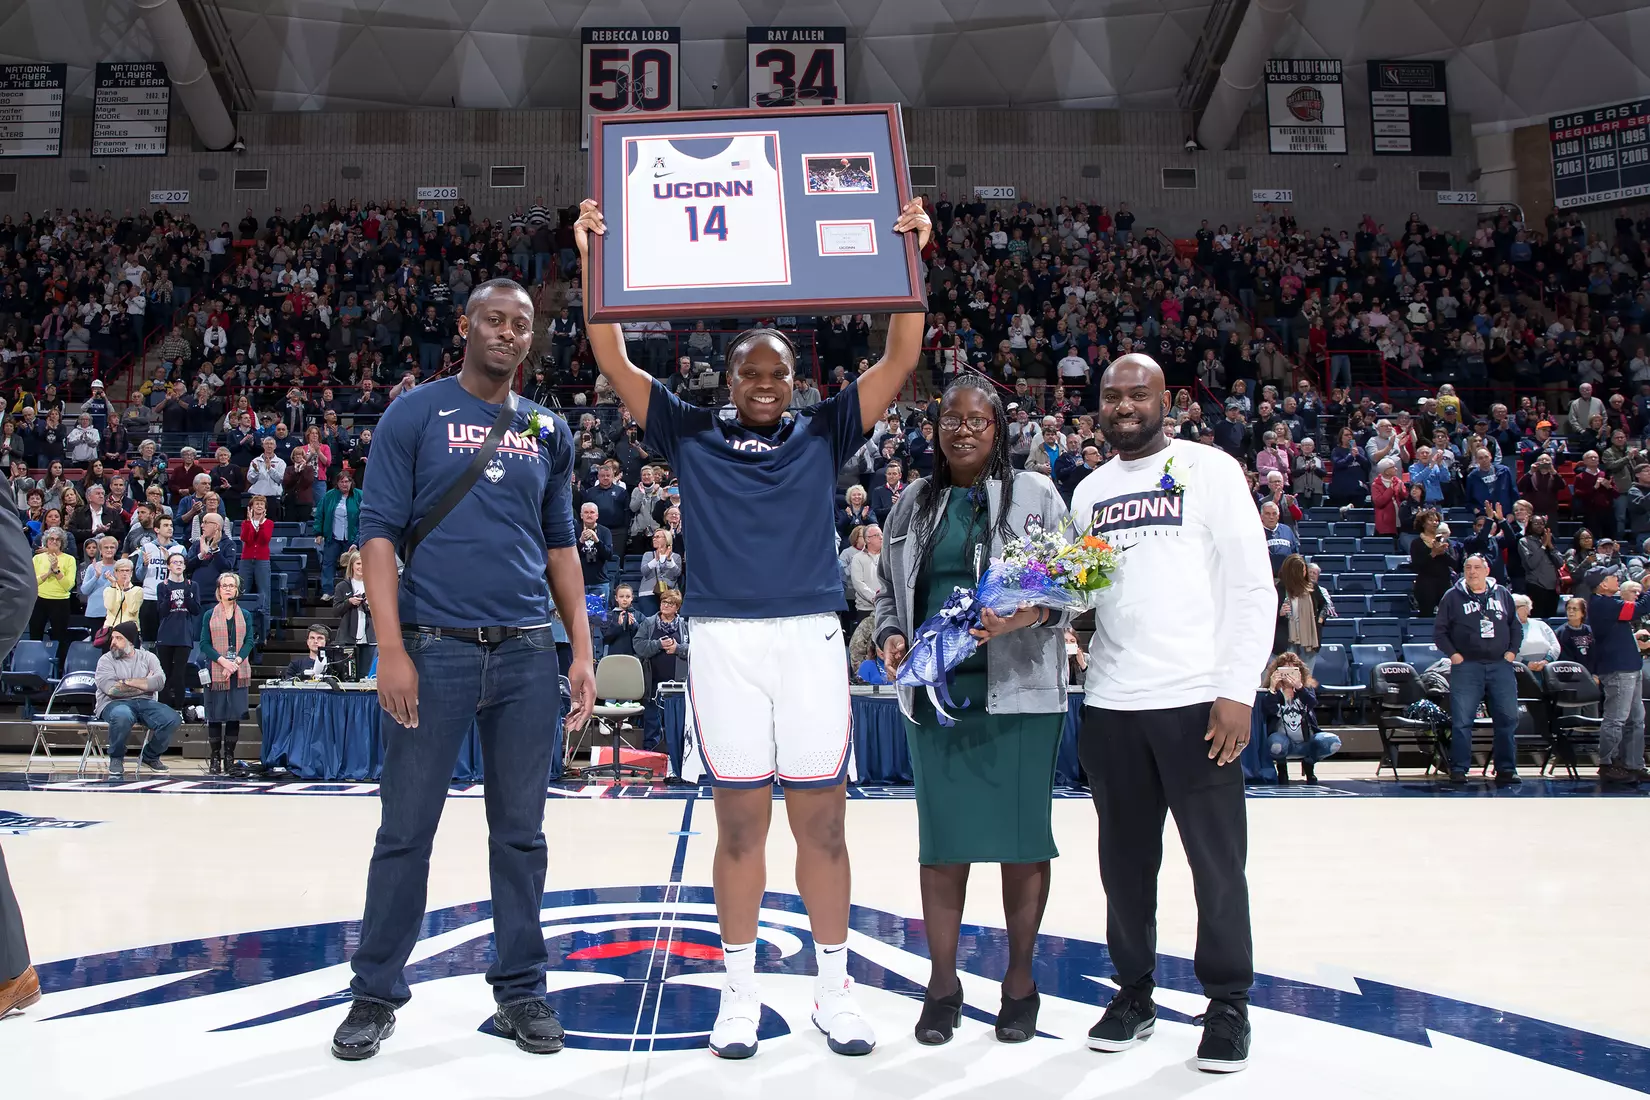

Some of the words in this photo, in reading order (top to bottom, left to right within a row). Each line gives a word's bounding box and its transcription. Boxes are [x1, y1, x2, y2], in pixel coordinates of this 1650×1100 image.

[592, 30, 639, 42] REBECCA
[642, 30, 670, 41] LOBO
[768, 30, 788, 41] RAY
[792, 30, 825, 41] ALLEN
[5, 65, 51, 73] NATIONAL
[110, 64, 157, 72] NATIONAL
[1265, 60, 1289, 74] GENO
[1293, 60, 1341, 74] AURIEMMA
[13, 80, 31, 88] THE
[34, 80, 59, 88] YEAR
[102, 79, 114, 87] OF
[140, 78, 165, 86] YEAR
[589, 48, 672, 112] 50
[755, 48, 838, 107] 34
[1554, 115, 1584, 129] BIG
[1594, 103, 1642, 122] EAST
[1555, 121, 1620, 140] REGULAR
[1621, 127, 1646, 144] 1995
[1556, 140, 1580, 156] 1990
[1588, 134, 1612, 151] 1994
[1588, 153, 1615, 170] 2005
[1621, 147, 1649, 165] 2006
[1556, 159, 1582, 176] 2003
[166, 192, 189, 201] 207
[434, 189, 457, 198] 208
[653, 180, 753, 200] UCONN
[993, 188, 1014, 197] 210
[1275, 191, 1292, 200] 211
[1457, 193, 1477, 202] 212
[1562, 186, 1650, 206] CONNECTICUT
[684, 205, 728, 242] 14
[449, 447, 540, 464] BASTBALL
[1093, 496, 1180, 529] UCONN
